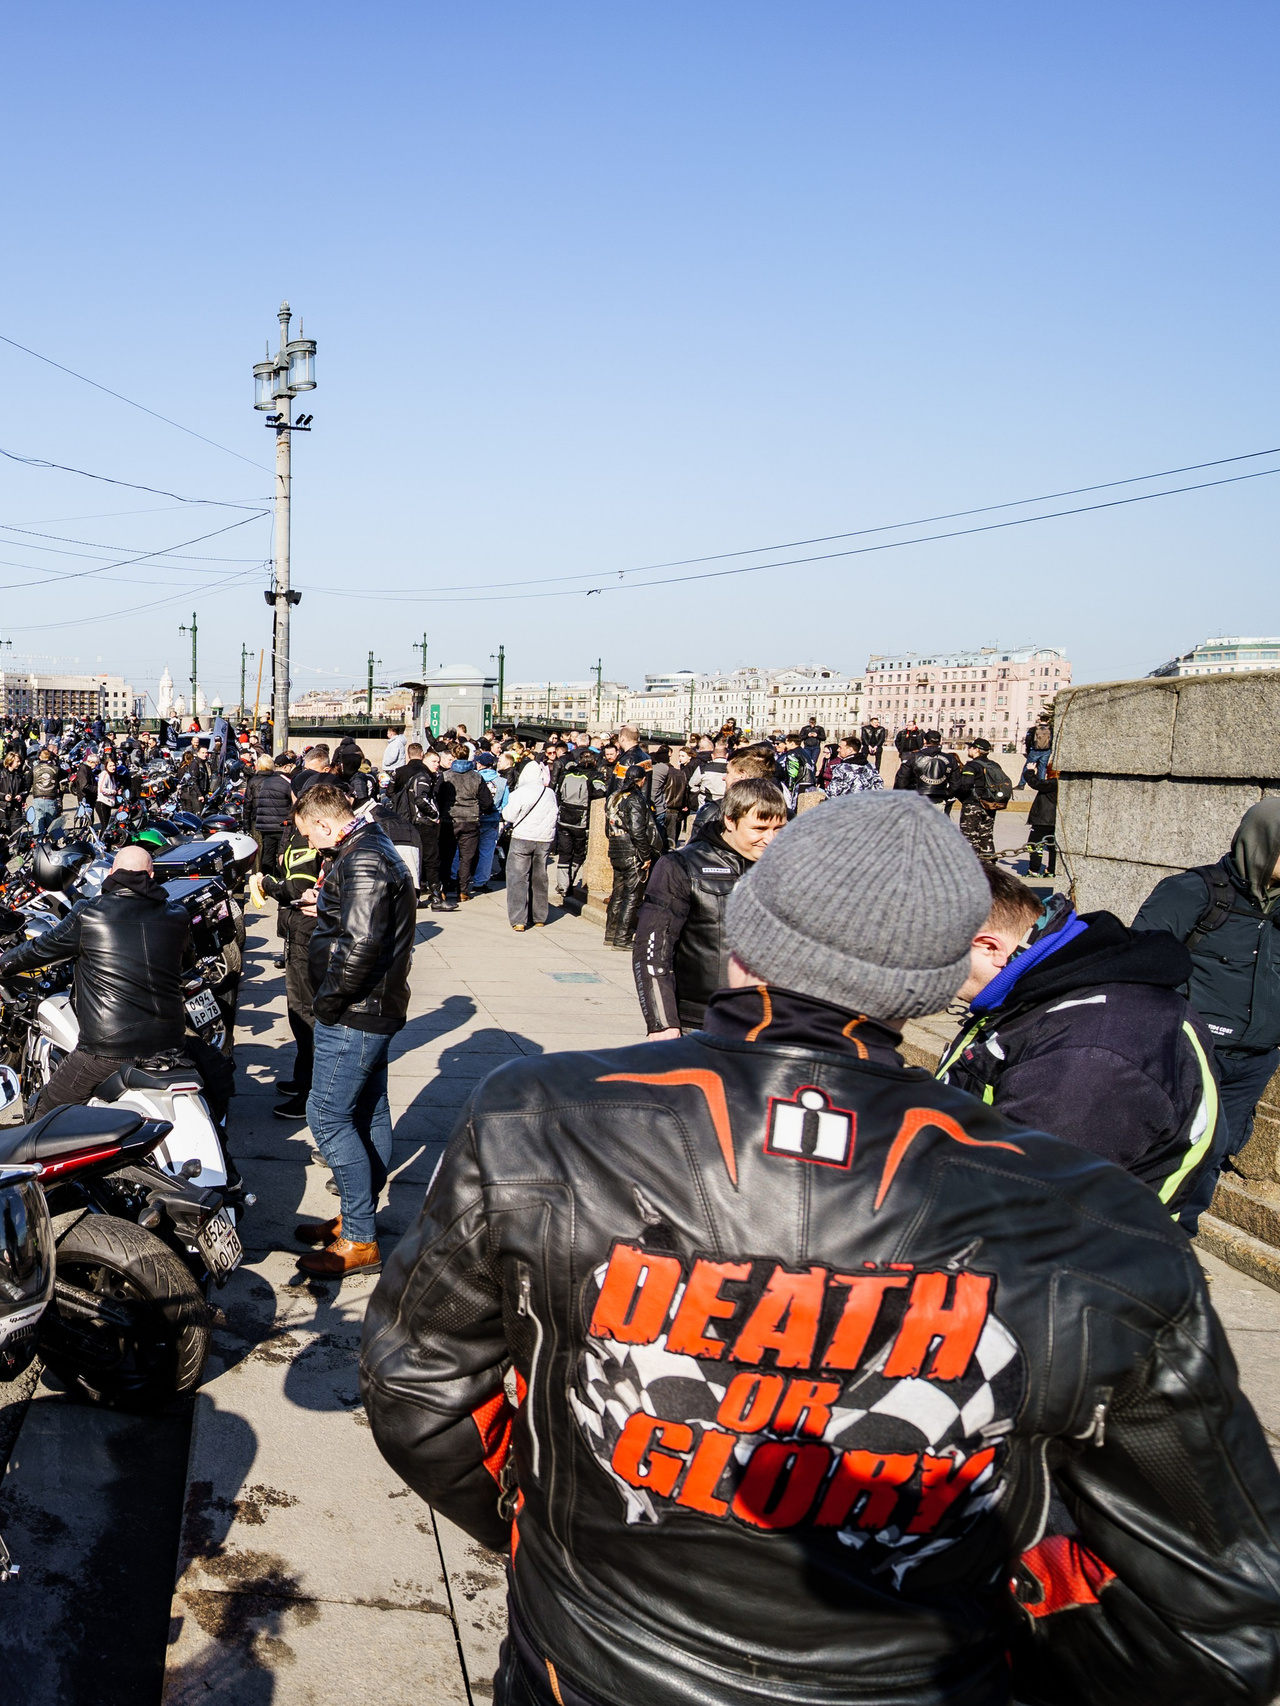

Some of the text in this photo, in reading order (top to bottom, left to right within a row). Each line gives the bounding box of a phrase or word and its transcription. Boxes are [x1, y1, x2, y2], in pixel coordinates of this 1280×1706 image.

[190, 992, 210, 1010] 0194
[194, 1005, 219, 1026] AP 78
[204, 1214, 227, 1249] 8520
[214, 1251, 228, 1275] AO
[227, 1235, 240, 1258] 78
[590, 1244, 991, 1381] DEATH
[717, 1372, 841, 1437] OR
[611, 1412, 996, 1534] GLORY
